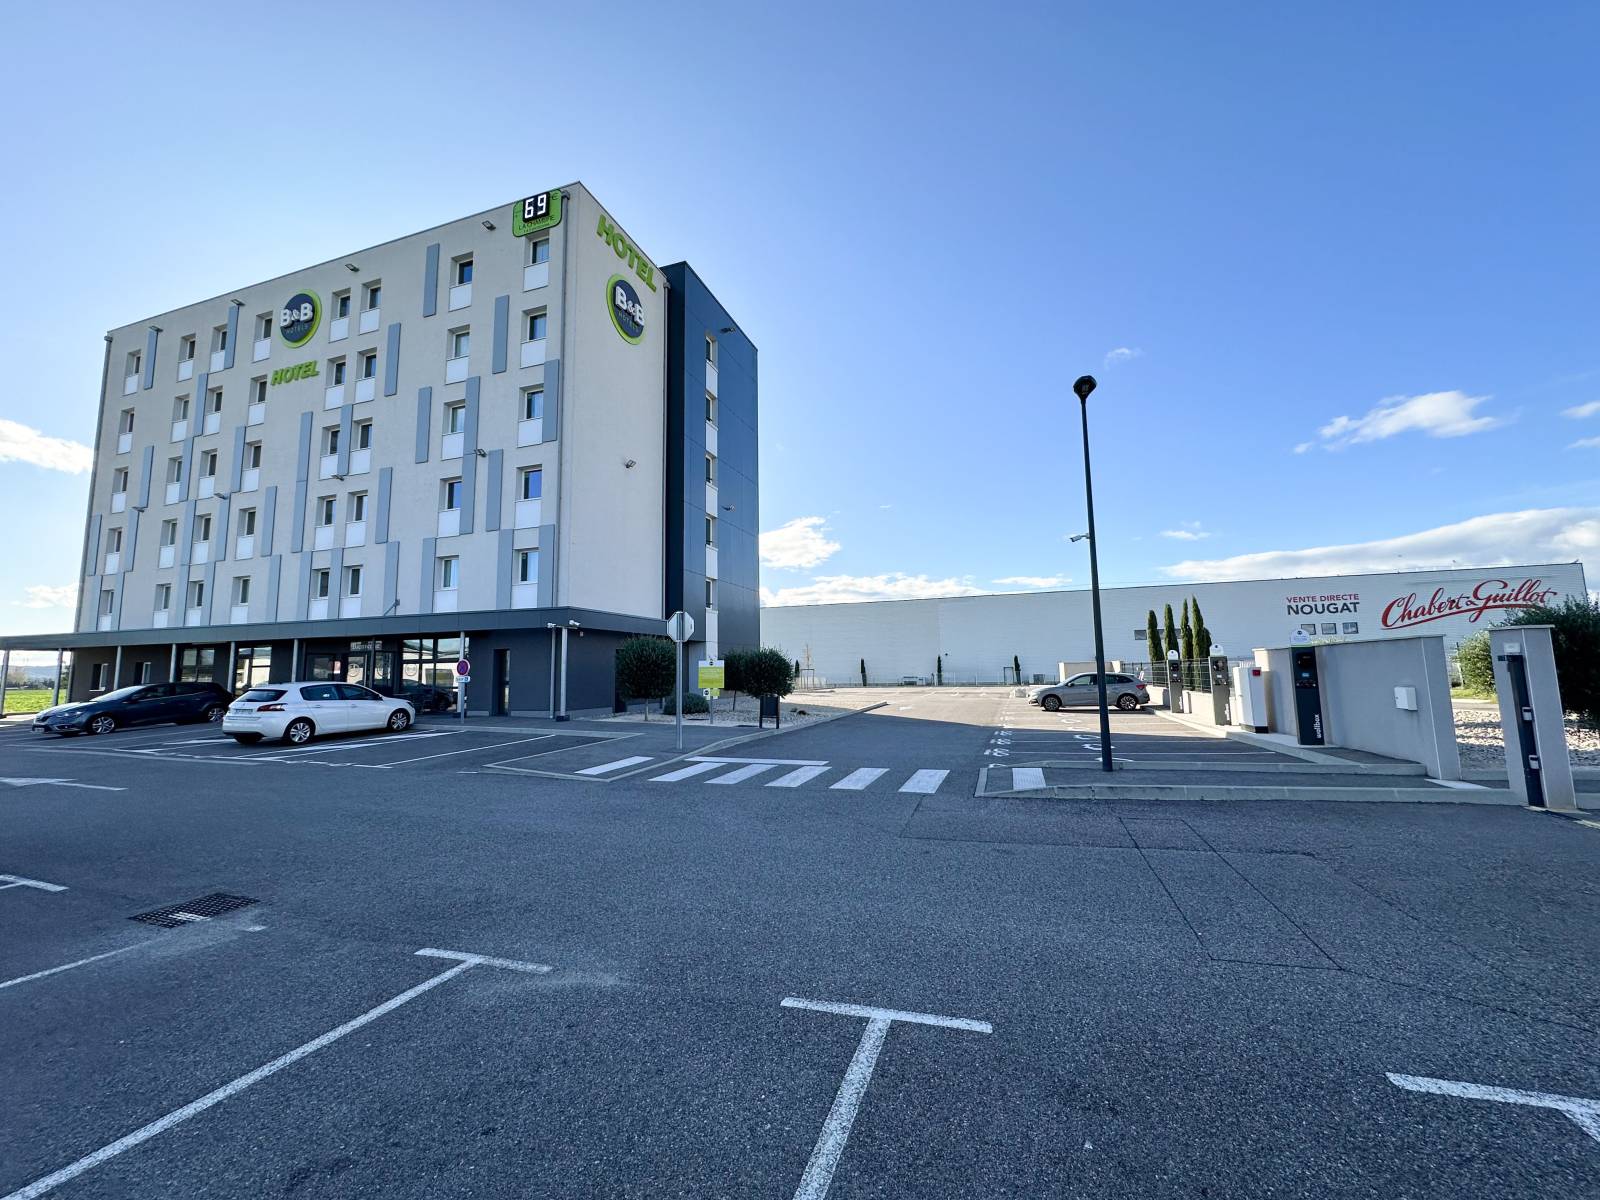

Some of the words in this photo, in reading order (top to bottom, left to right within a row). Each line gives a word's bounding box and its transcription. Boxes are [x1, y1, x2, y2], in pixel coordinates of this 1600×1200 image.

[524, 194, 547, 219] 69
[597, 214, 656, 293] HOTEL
[280, 302, 314, 327] B&B
[615, 285, 645, 327] B&B
[271, 360, 320, 386] HOTEL
[1286, 594, 1317, 604] VENTE
[1319, 593, 1359, 602] DIRECTE
[1287, 601, 1360, 616] NOUGAT
[1381, 587, 1470, 628] Chabert
[1469, 578, 1558, 624] Guillot
[1313, 714, 1322, 739] wallbox
